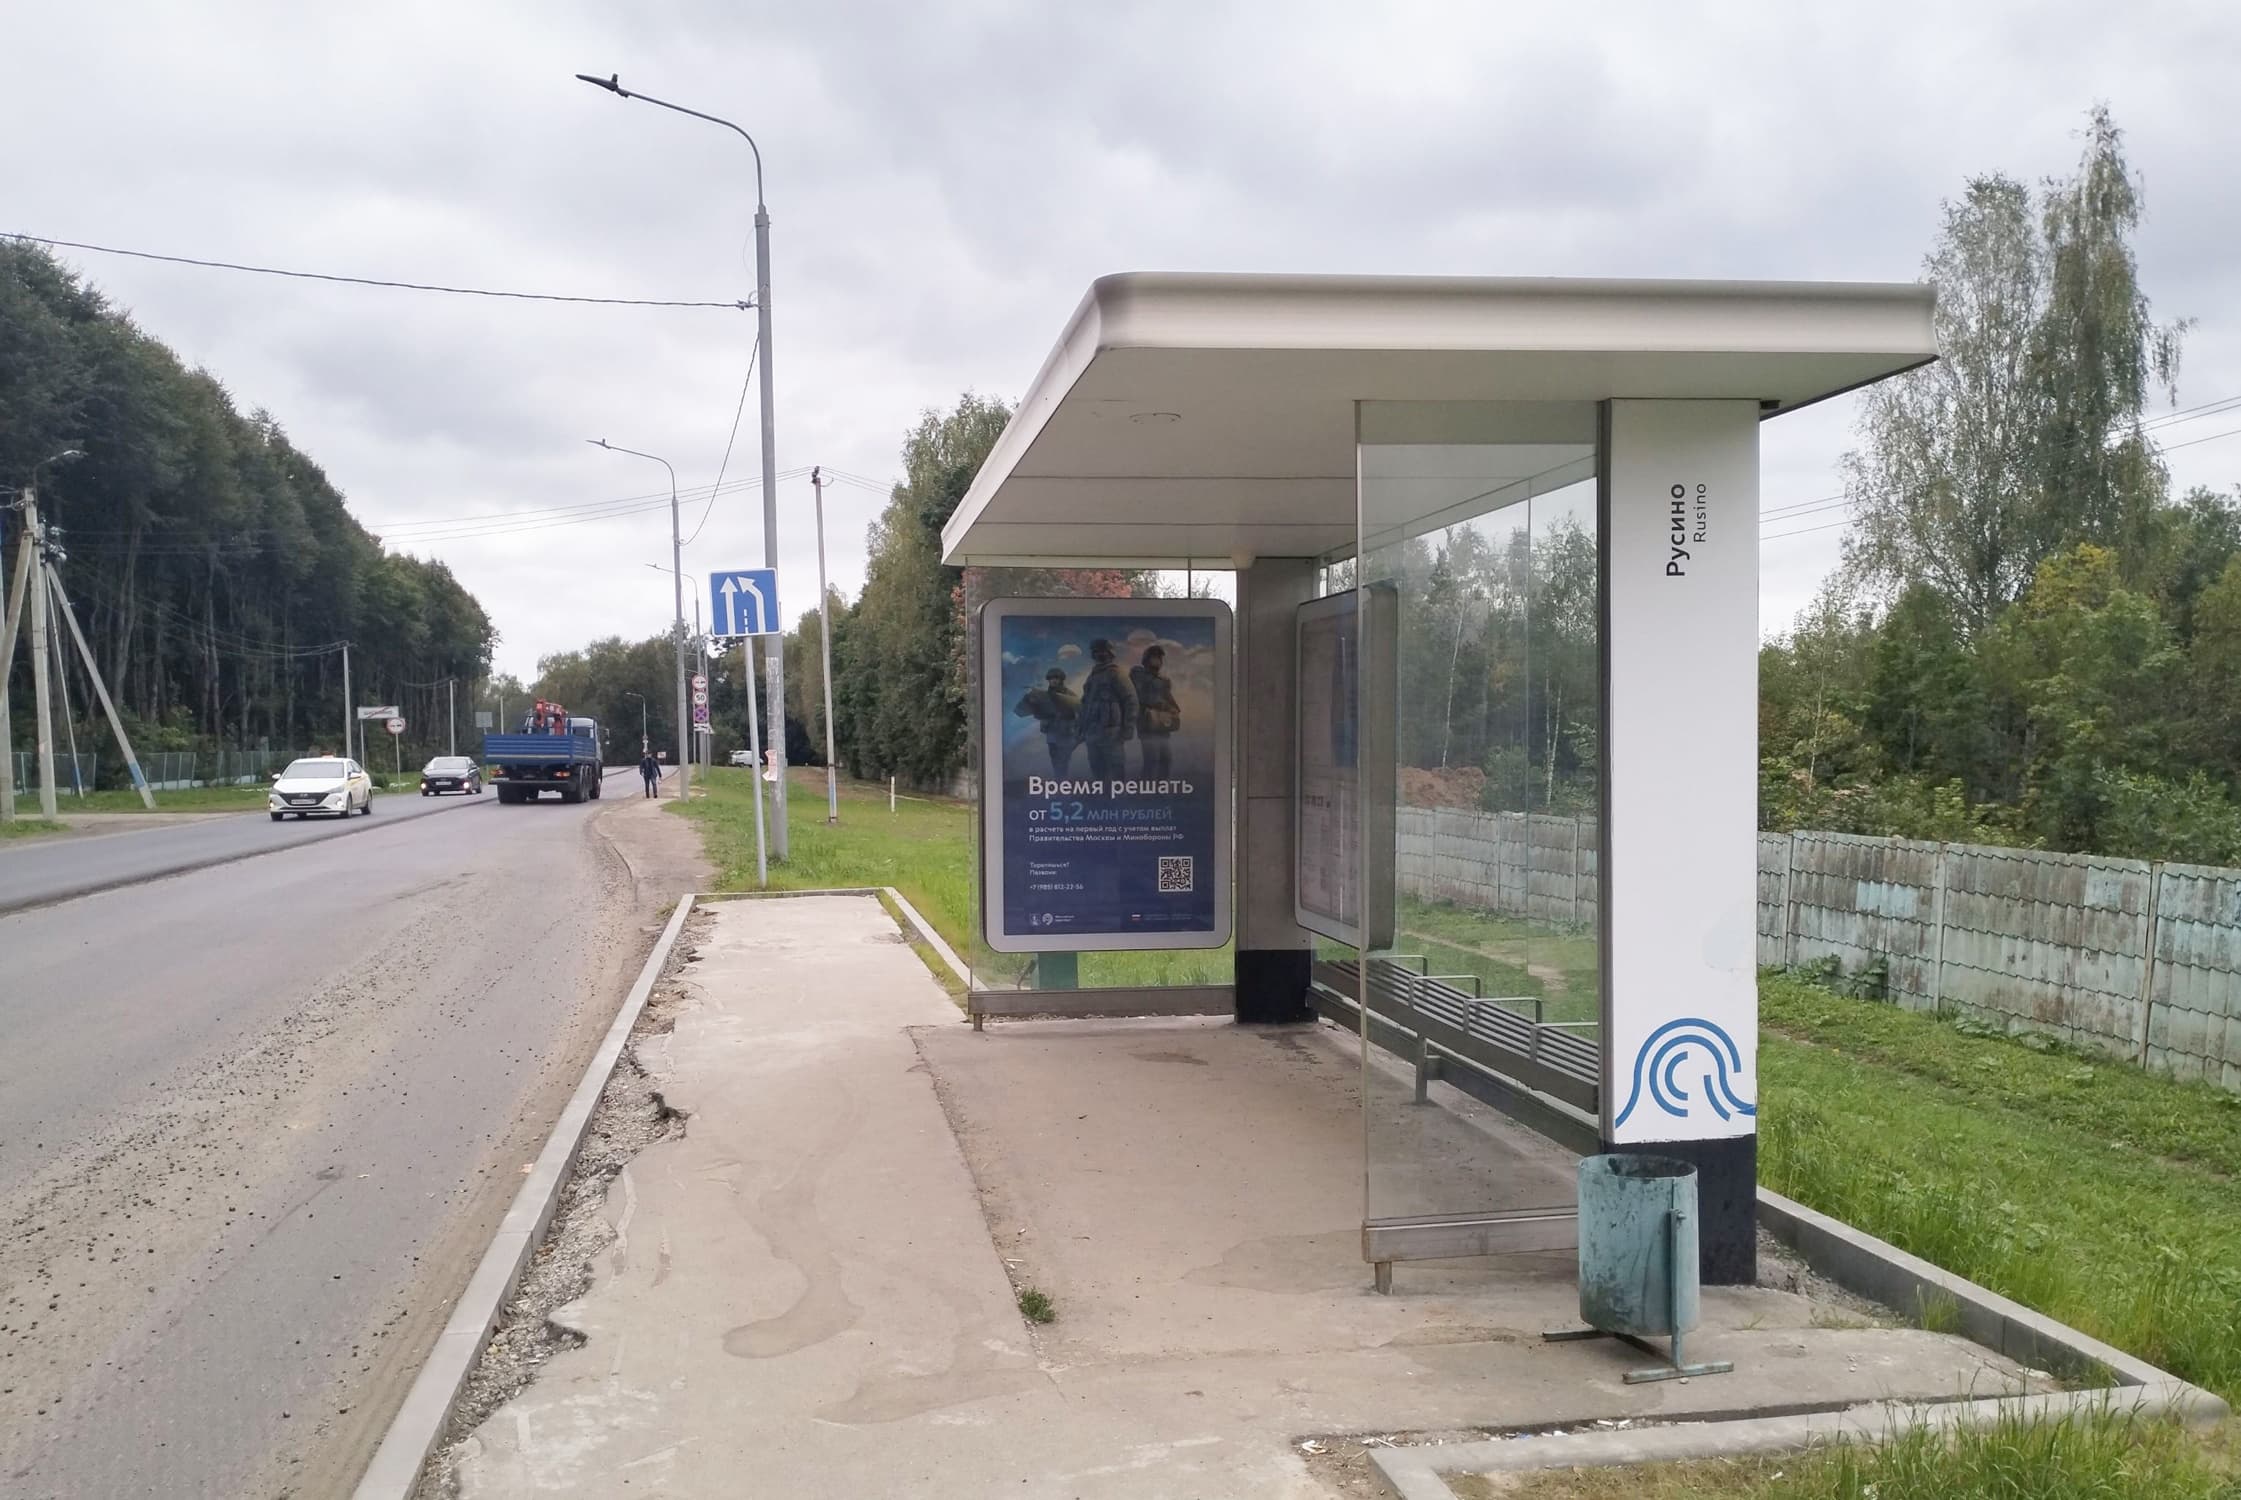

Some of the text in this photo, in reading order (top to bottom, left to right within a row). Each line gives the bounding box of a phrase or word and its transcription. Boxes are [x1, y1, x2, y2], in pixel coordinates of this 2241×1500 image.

[1693, 483, 1707, 543] Rusino
[1666, 484, 1690, 577] Русино
[1028, 775, 1194, 799] Время решать
[1050, 801, 1084, 823] 5,2
[1087, 809, 1119, 821] МЛН
[1122, 806, 1172, 821] РУБЛЕЙ
[1029, 834, 1084, 842] Правительства
[1085, 833, 1115, 841] Москвы
[1123, 833, 1171, 842] Минобороны
[1173, 832, 1185, 840] РФ
[1075, 825, 1103, 834] первый
[1123, 826, 1150, 834] учетом
